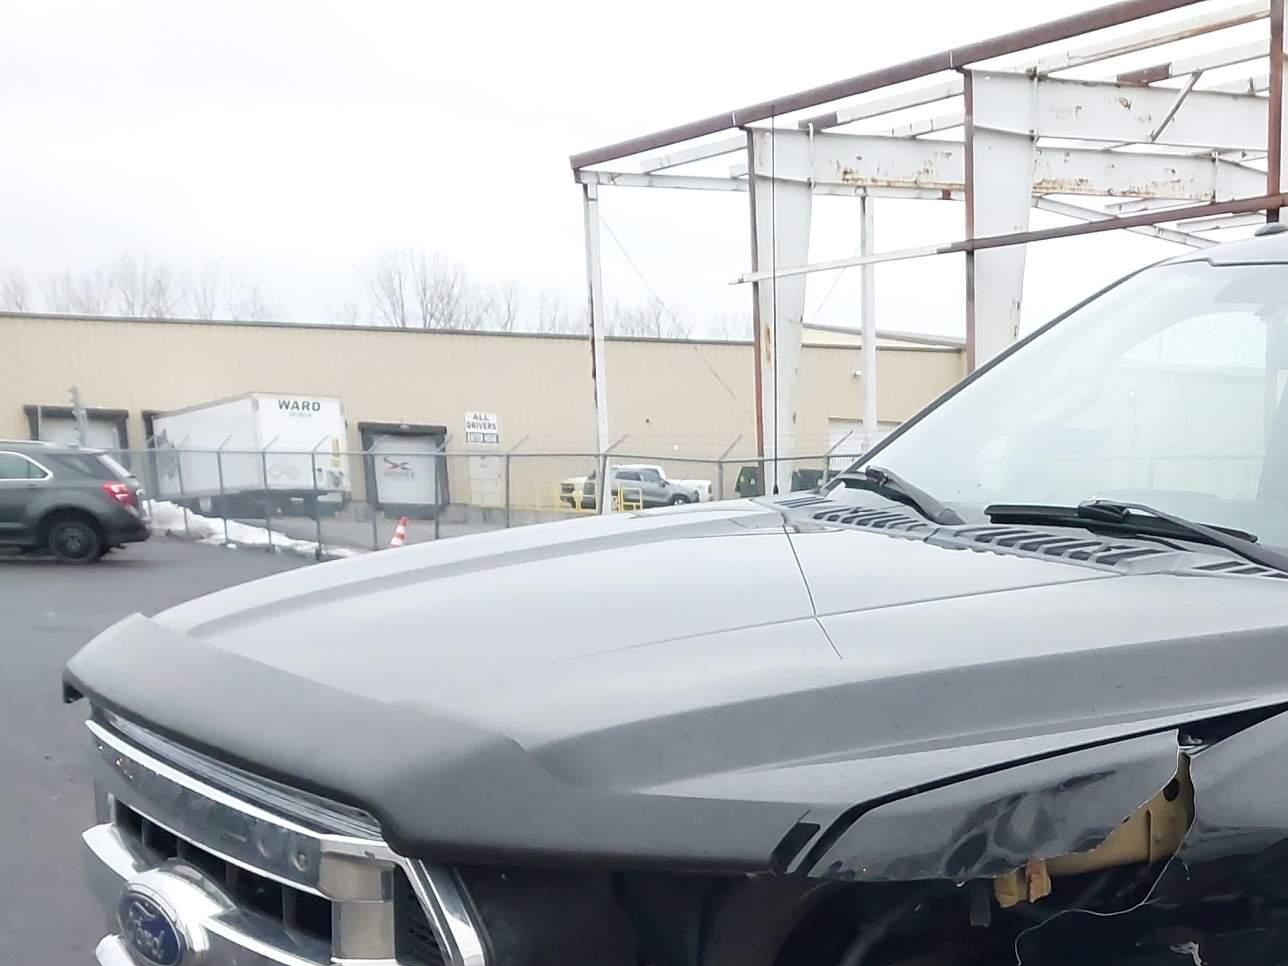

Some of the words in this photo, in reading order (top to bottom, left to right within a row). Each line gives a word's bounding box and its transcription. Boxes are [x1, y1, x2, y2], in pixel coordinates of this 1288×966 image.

[278, 399, 321, 412] WARD
[472, 413, 490, 421] ALL
[466, 421, 497, 430] DRIVERS
[129, 901, 167, 959] Ford
